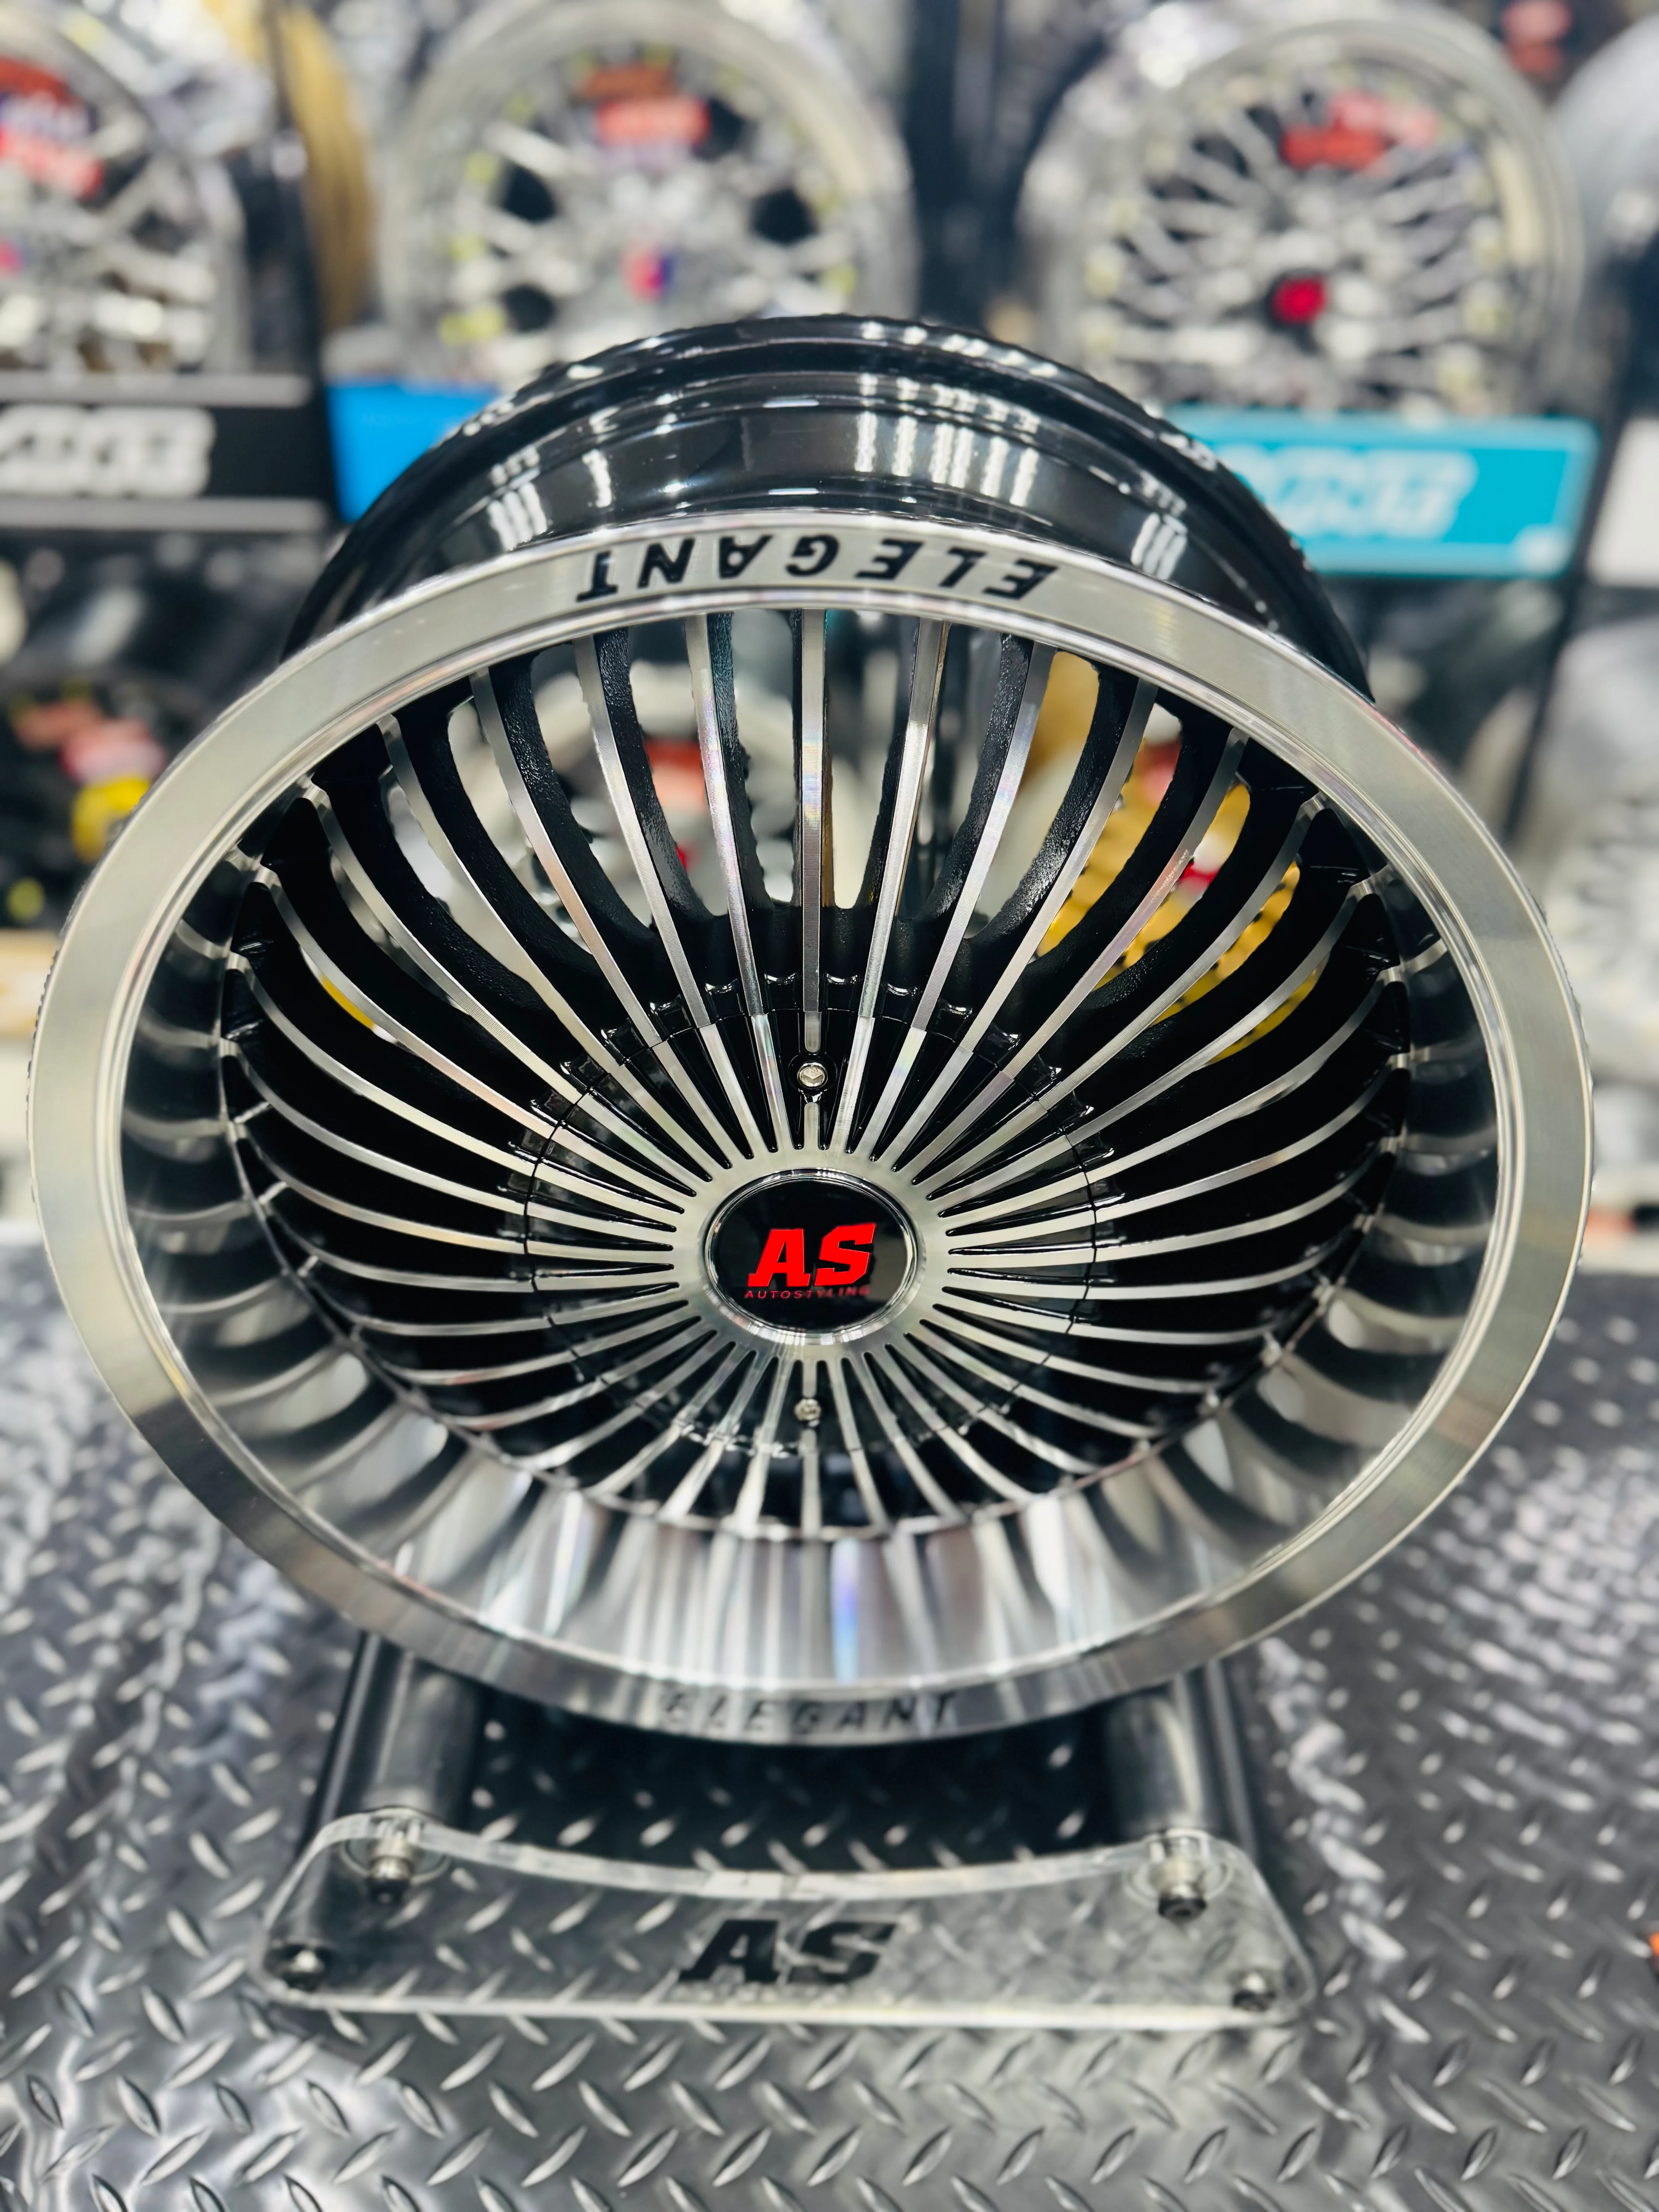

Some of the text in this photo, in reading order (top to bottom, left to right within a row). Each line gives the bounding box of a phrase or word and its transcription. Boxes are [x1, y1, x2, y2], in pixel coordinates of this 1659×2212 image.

[576, 534, 1059, 602] ELEGANT
[747, 1223, 876, 1287] AS
[744, 1285, 871, 1299] AUTOSTYLING
[660, 1690, 957, 1735] ELEGANT
[678, 1919, 897, 1985] AS
